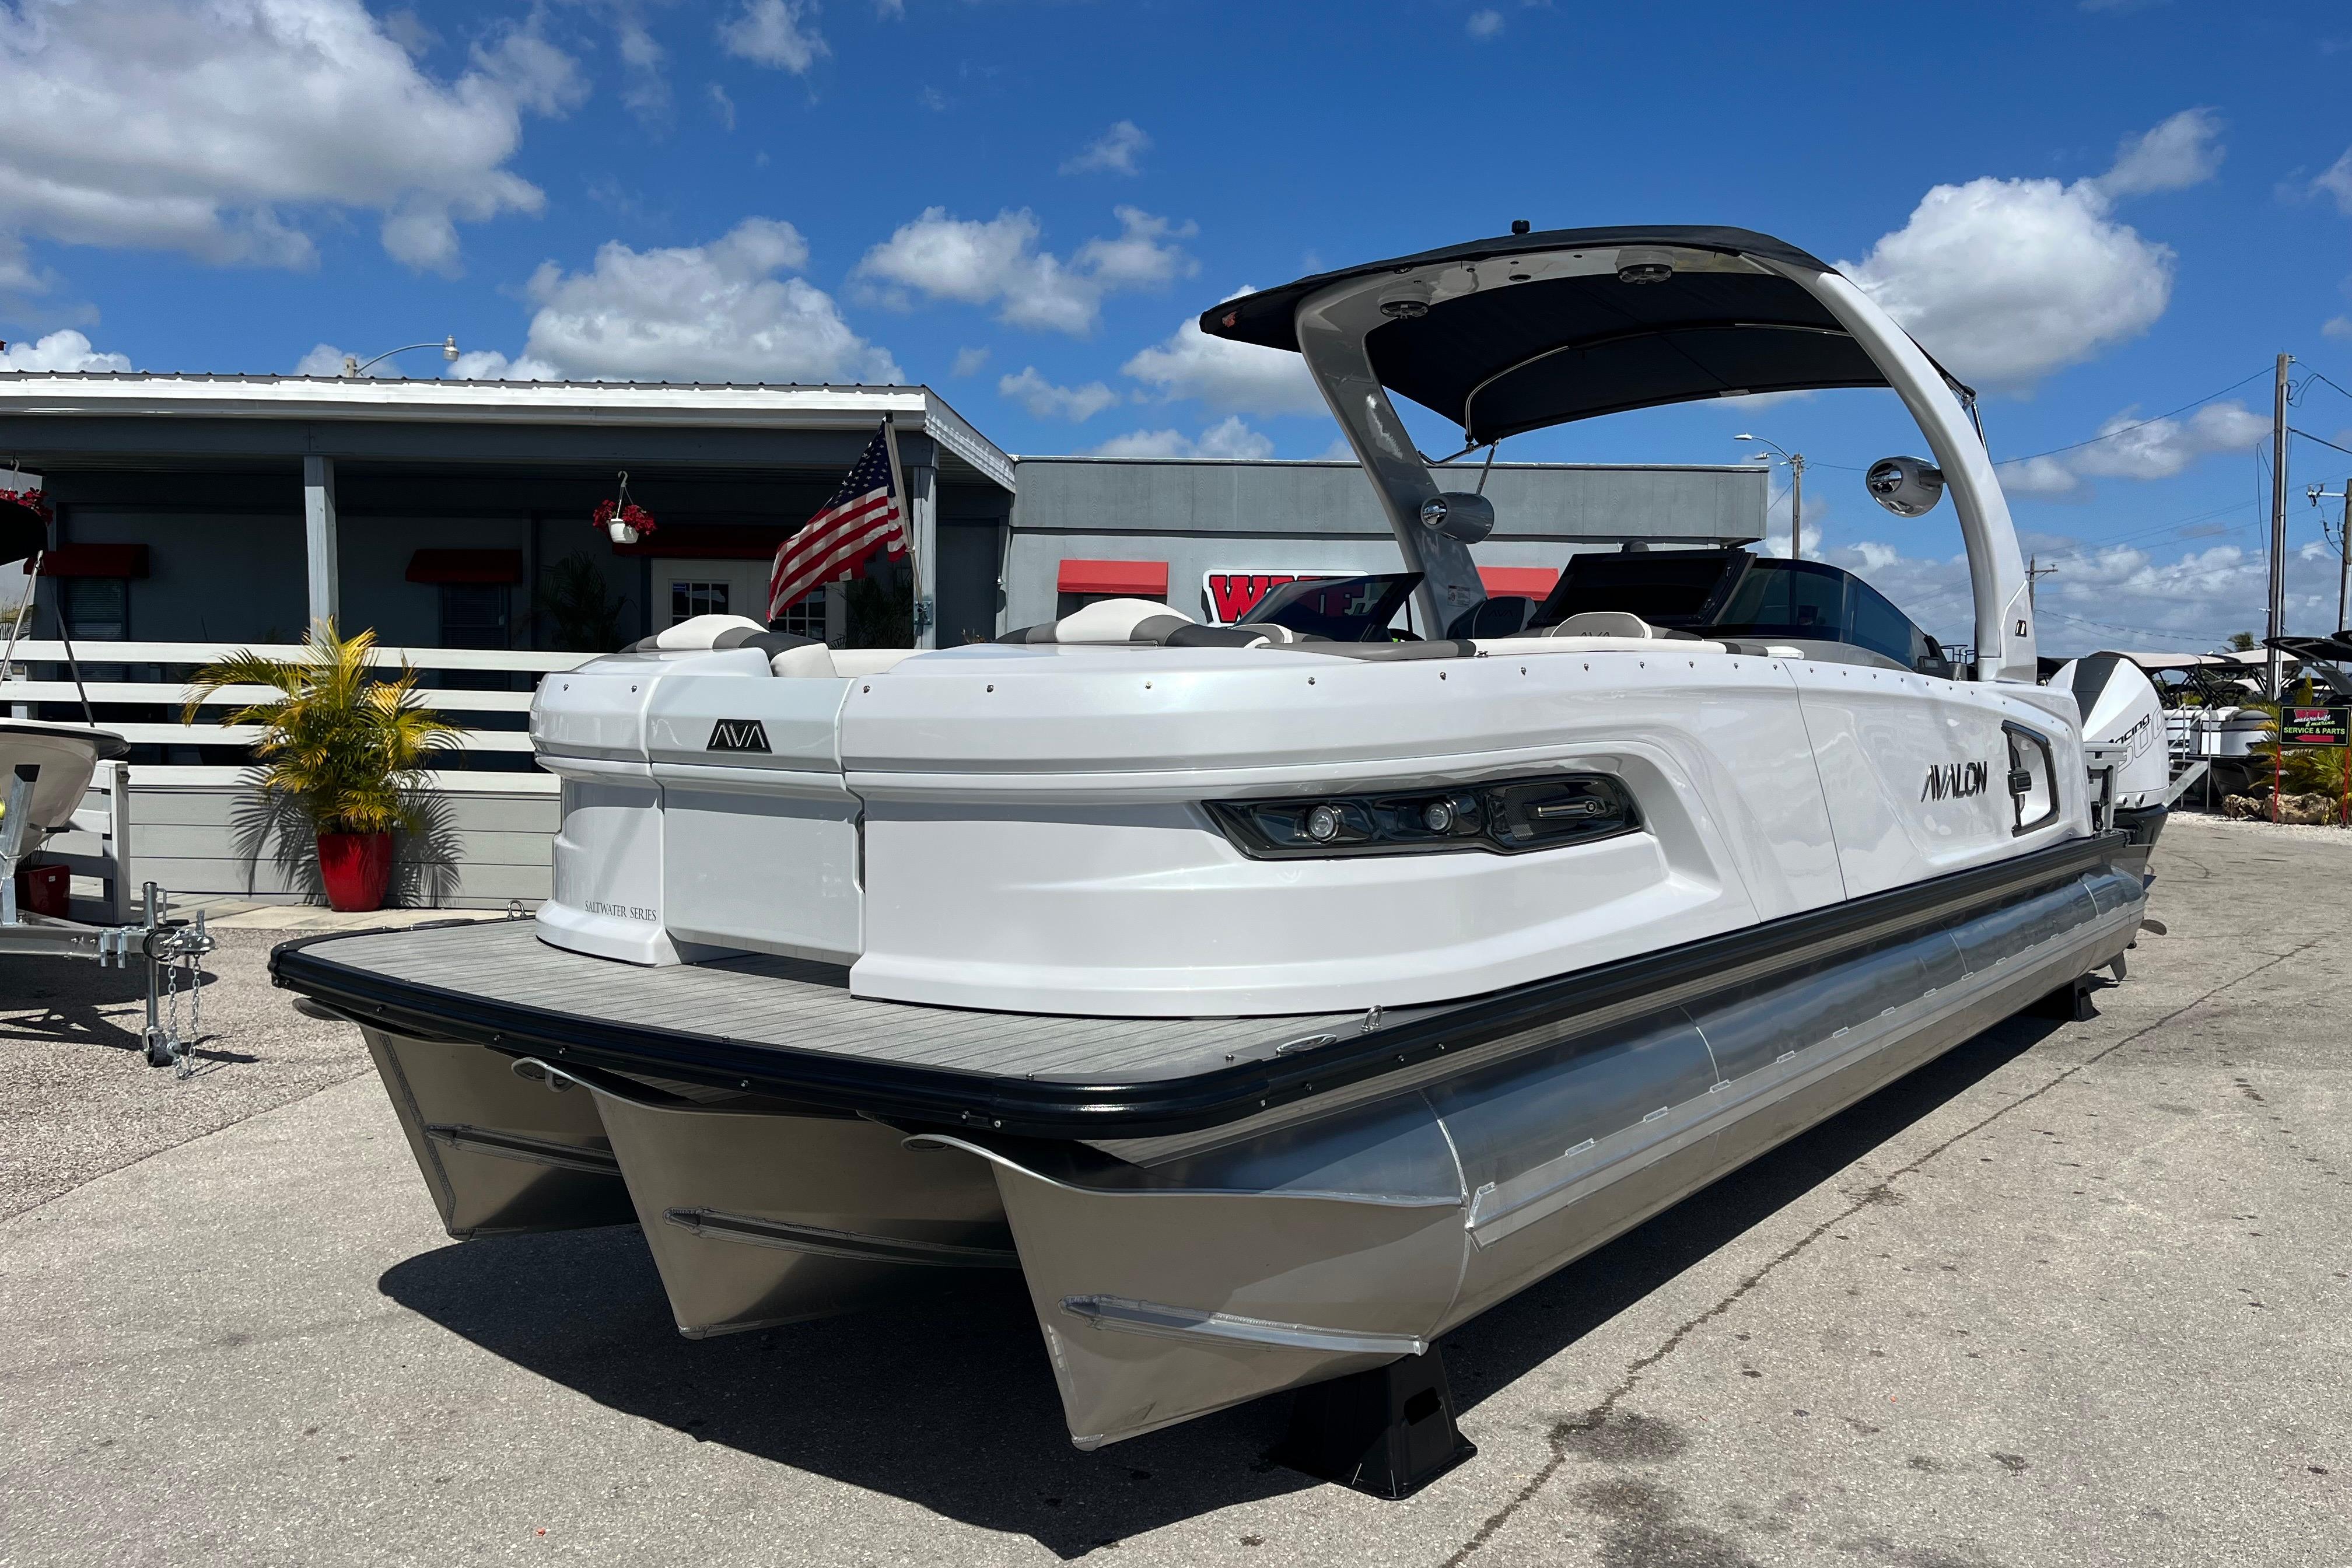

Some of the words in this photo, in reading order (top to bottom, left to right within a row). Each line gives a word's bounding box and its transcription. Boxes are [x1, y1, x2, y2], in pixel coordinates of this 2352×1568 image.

[710, 722, 766, 748] AVA
[2108, 713, 2150, 744] acing
[1920, 761, 1987, 803] AVALON
[584, 900, 627, 918] SALTWATER
[630, 907, 656, 922] SERIES
